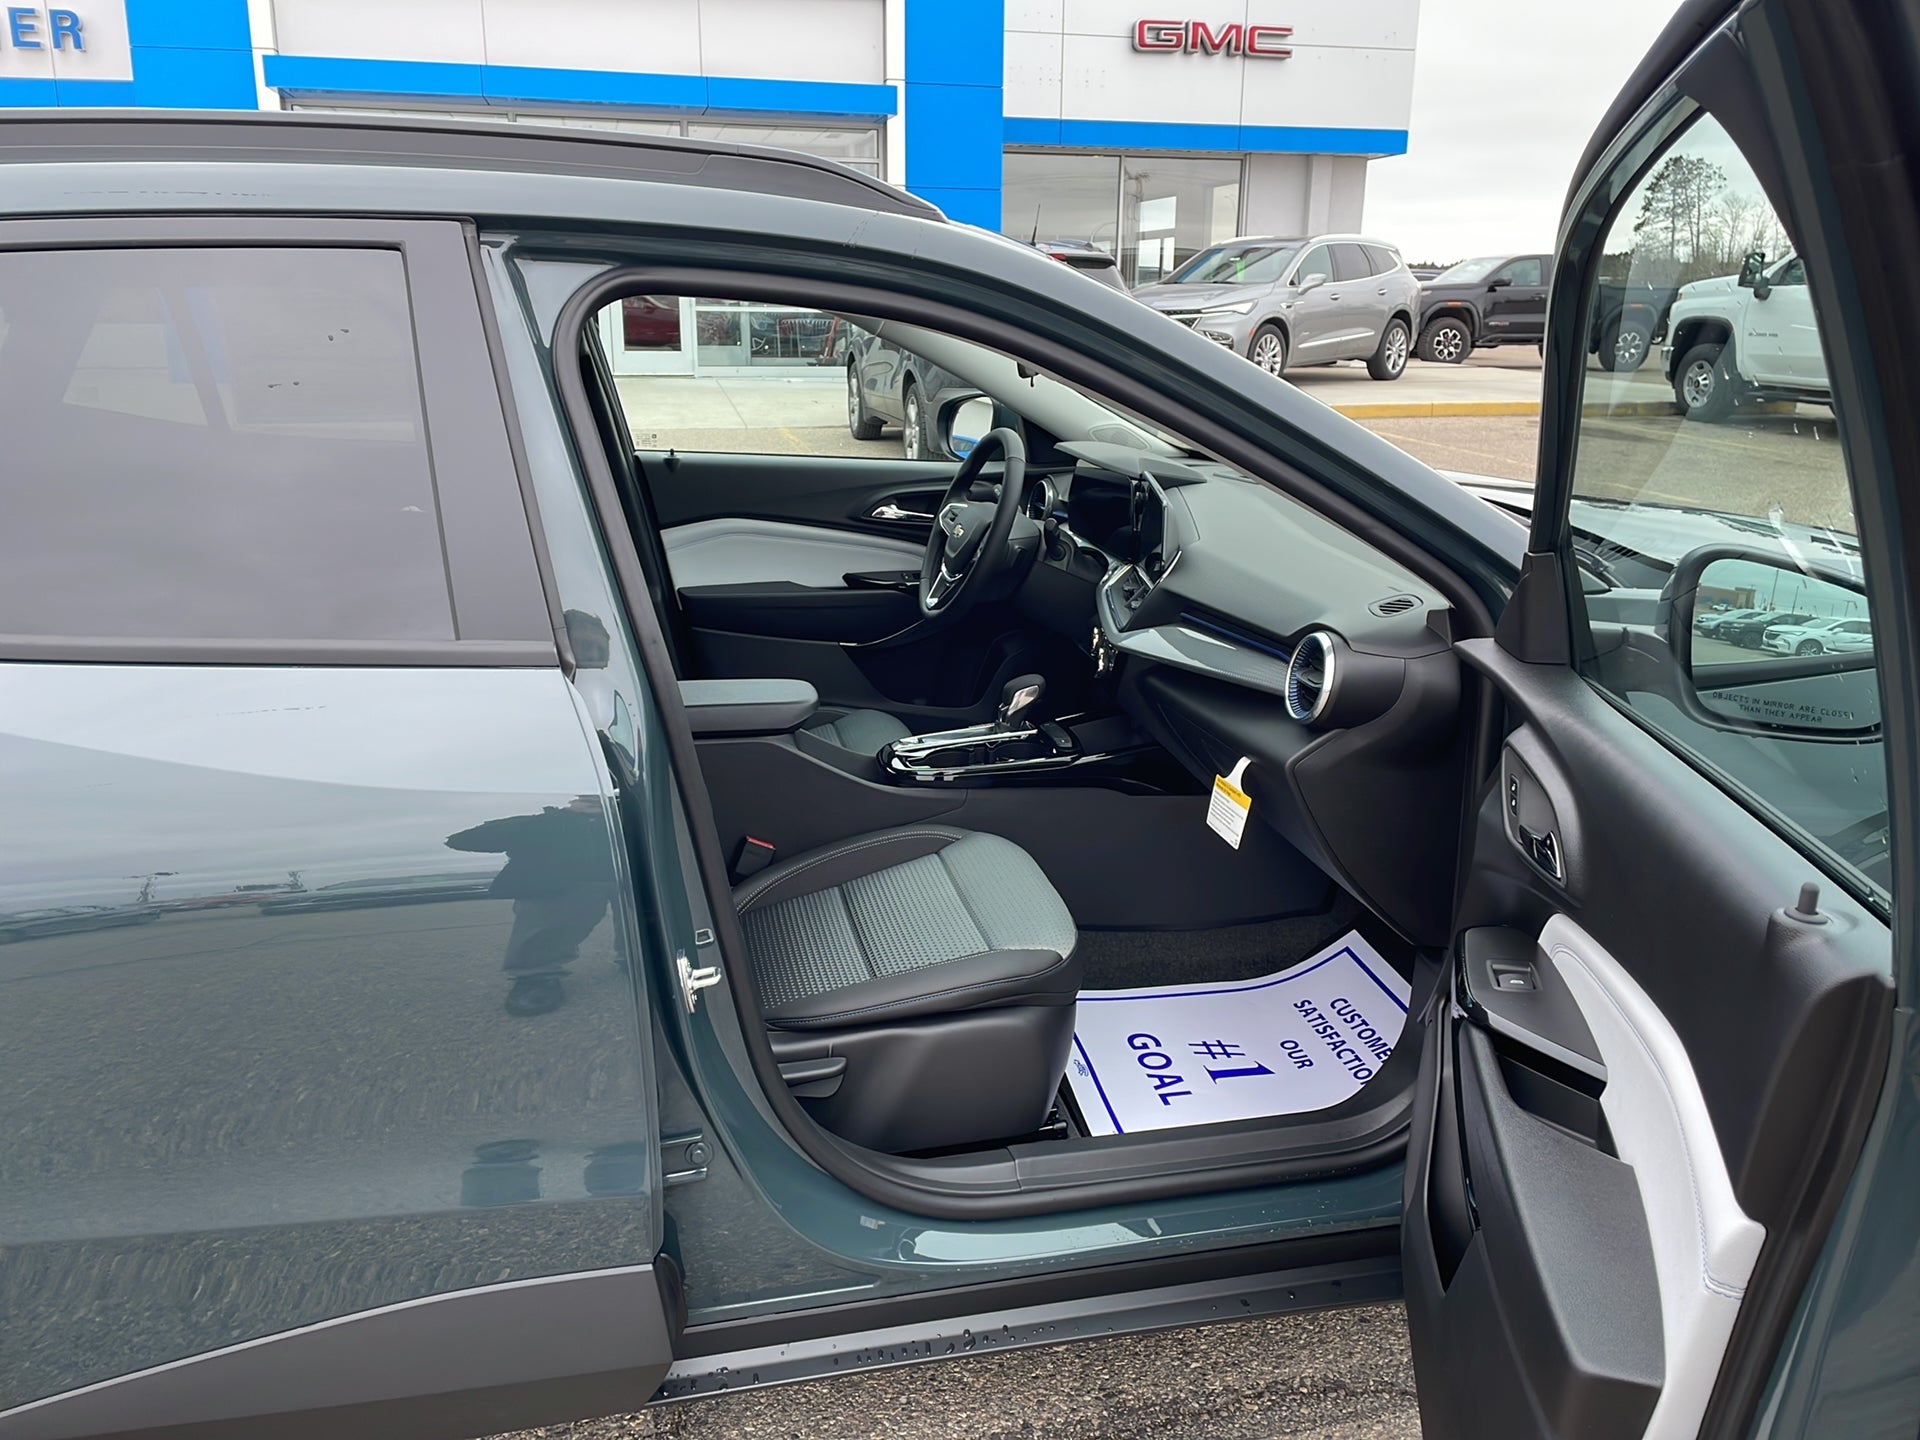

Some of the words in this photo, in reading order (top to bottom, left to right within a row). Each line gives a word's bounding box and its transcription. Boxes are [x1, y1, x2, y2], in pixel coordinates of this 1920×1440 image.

[7, 7, 84, 50] ER
[1133, 18, 1292, 58] GMC
[1712, 691, 1749, 703] OBJECTS
[1763, 700, 1794, 710] MIRROR
[1799, 705, 1816, 713] ARE
[1740, 704, 1761, 713] THAN
[1764, 708, 1786, 718] THEY
[1789, 712, 1822, 723] APPEAR
[1293, 999, 1373, 1085] SATISFACTIO
[1330, 998, 1393, 1063] CUSTOME
[1127, 1033, 1192, 1106] GOAL
[1188, 1039, 1276, 1084] #1
[1280, 1040, 1314, 1069] OUR
